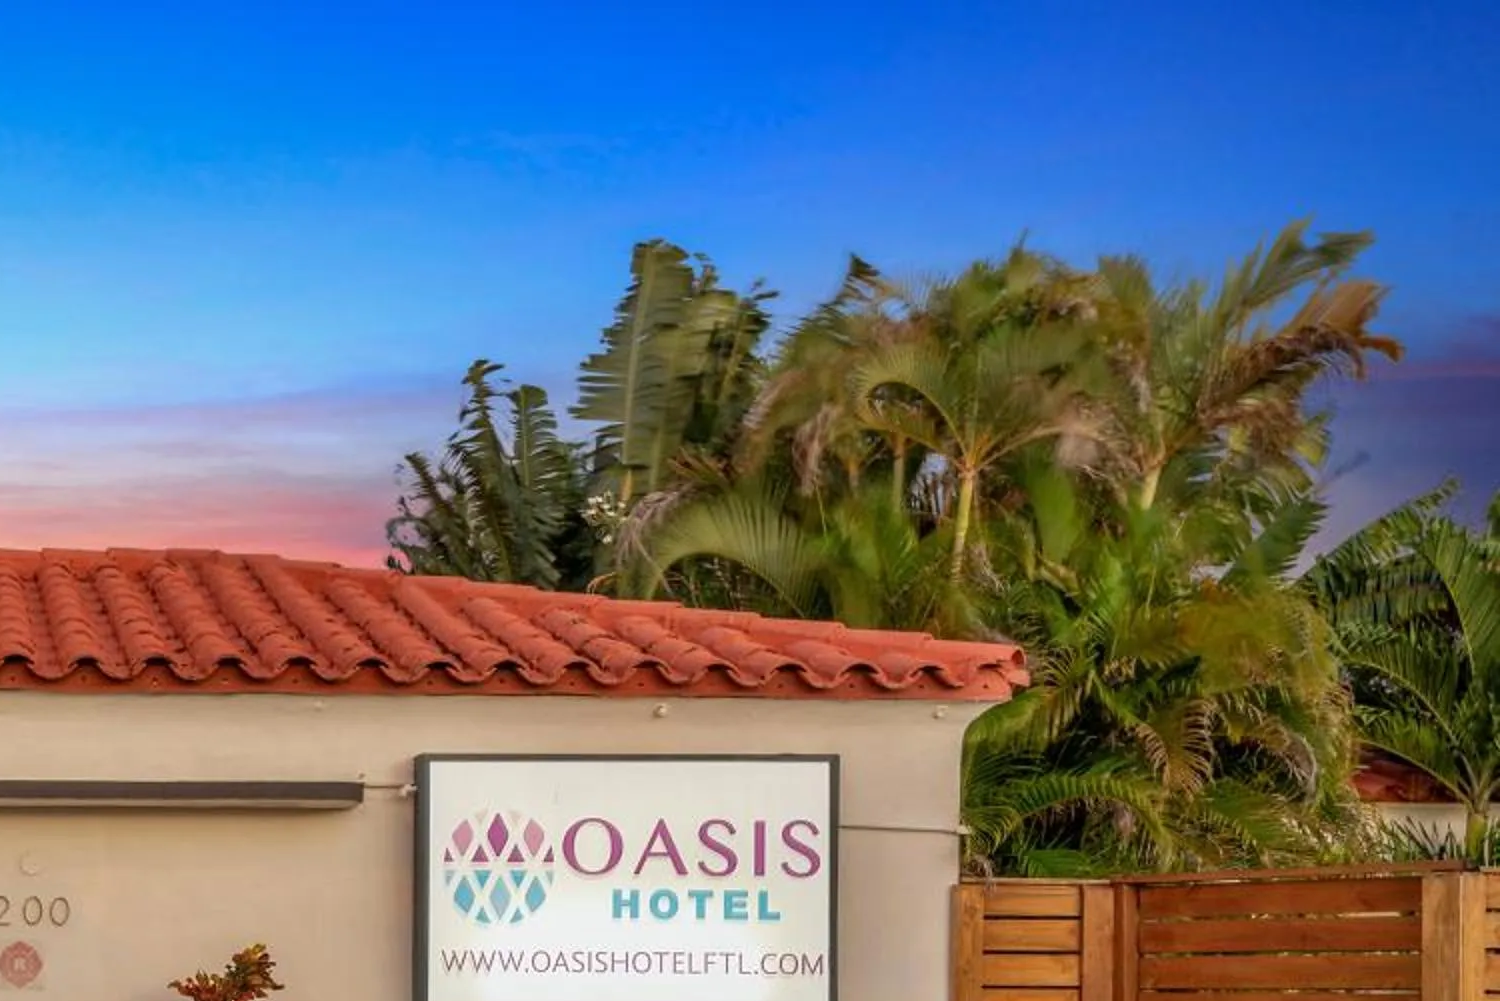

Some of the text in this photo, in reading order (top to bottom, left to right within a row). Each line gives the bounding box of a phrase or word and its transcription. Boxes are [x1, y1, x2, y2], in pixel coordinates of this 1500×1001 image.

[562, 817, 821, 878] OASIS
[612, 889, 781, 921] HOTEL
[440, 949, 824, 977] WWW.OASISHOTELFTL.COM
